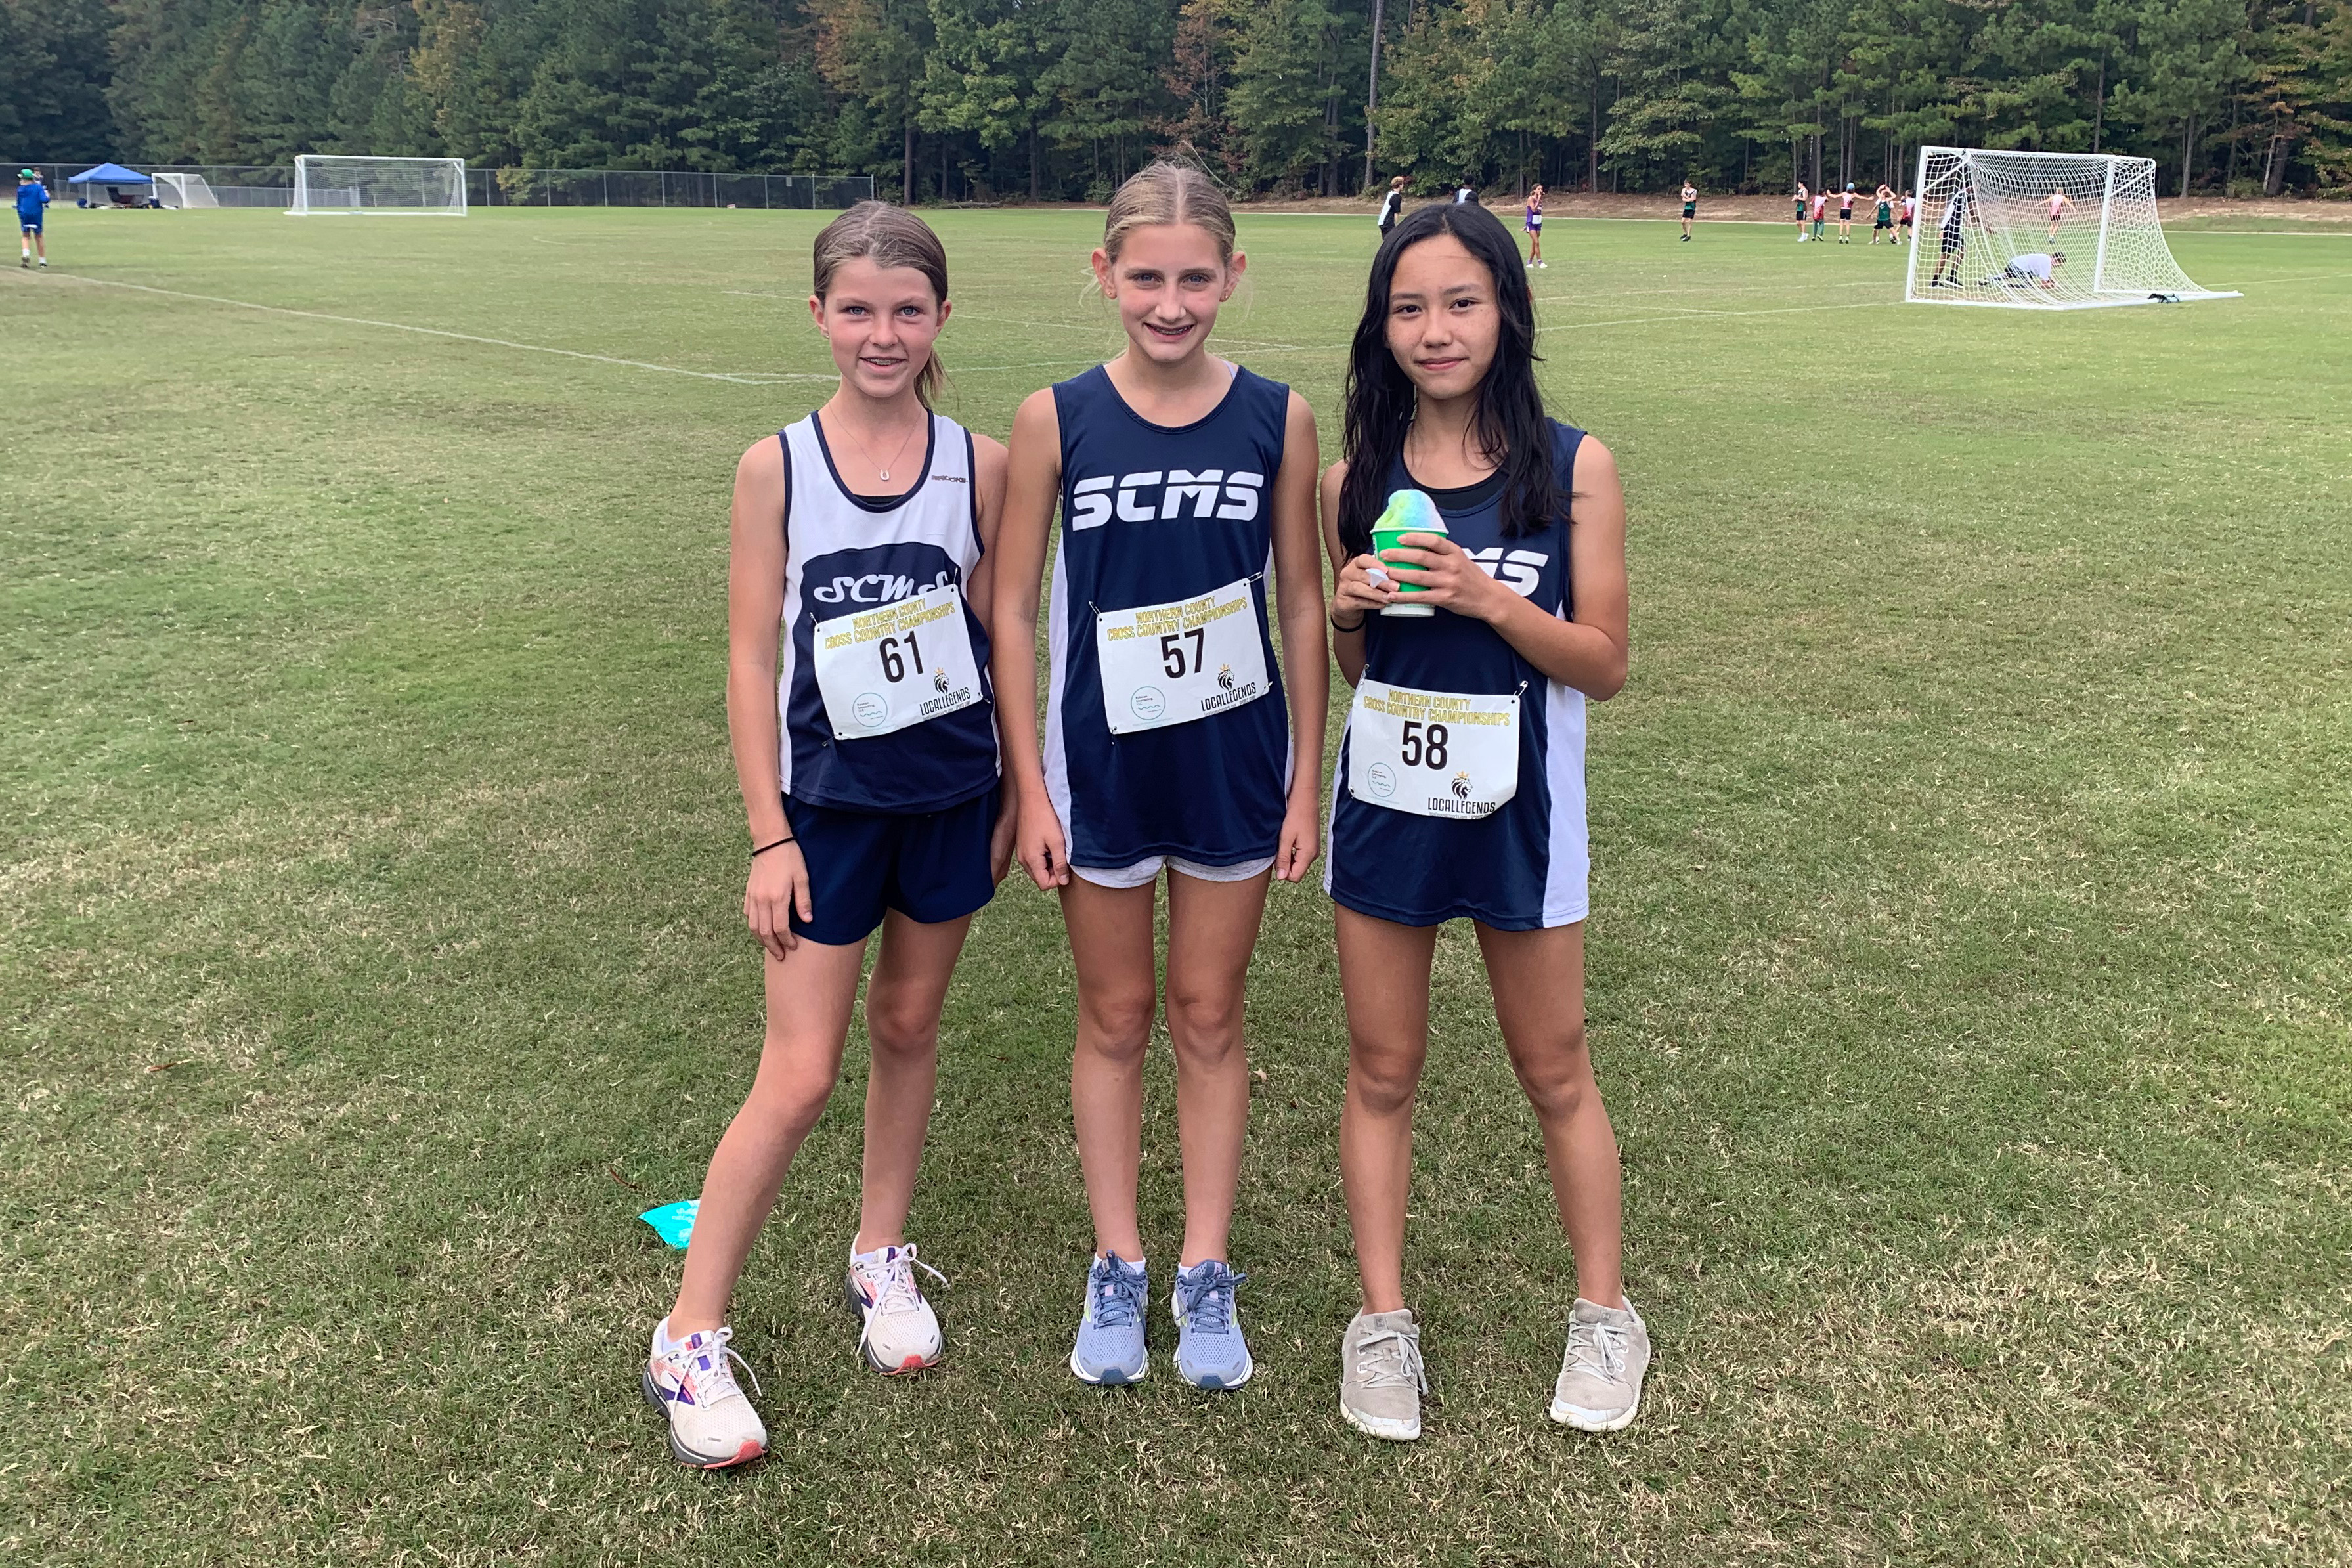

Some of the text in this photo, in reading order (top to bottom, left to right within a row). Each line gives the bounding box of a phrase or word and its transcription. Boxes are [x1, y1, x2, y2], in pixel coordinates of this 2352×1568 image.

[1072, 469, 1264, 531] SCMS
[825, 601, 955, 649] CROSS COUNTRY CHAMPIONSHIPS
[852, 598, 926, 630] NORTHERN COUNTY
[1107, 596, 1248, 641] CROSS COUNTRY CHAMPIONSHIPS
[1135, 596, 1215, 624] NORTHERN COUNTY
[879, 630, 925, 683] 61
[1160, 628, 1204, 678] 57
[919, 687, 971, 716] LOCALLEGENDS
[1200, 682, 1257, 711] LOCALLEGENDS
[1364, 695, 1510, 726] CROSS COUNTRY CHAMPIONSHIPS
[1389, 689, 1471, 710] NORTHERN COUNTY
[1401, 720, 1448, 770] 58
[1427, 797, 1496, 814] LOCALLEGENDS
